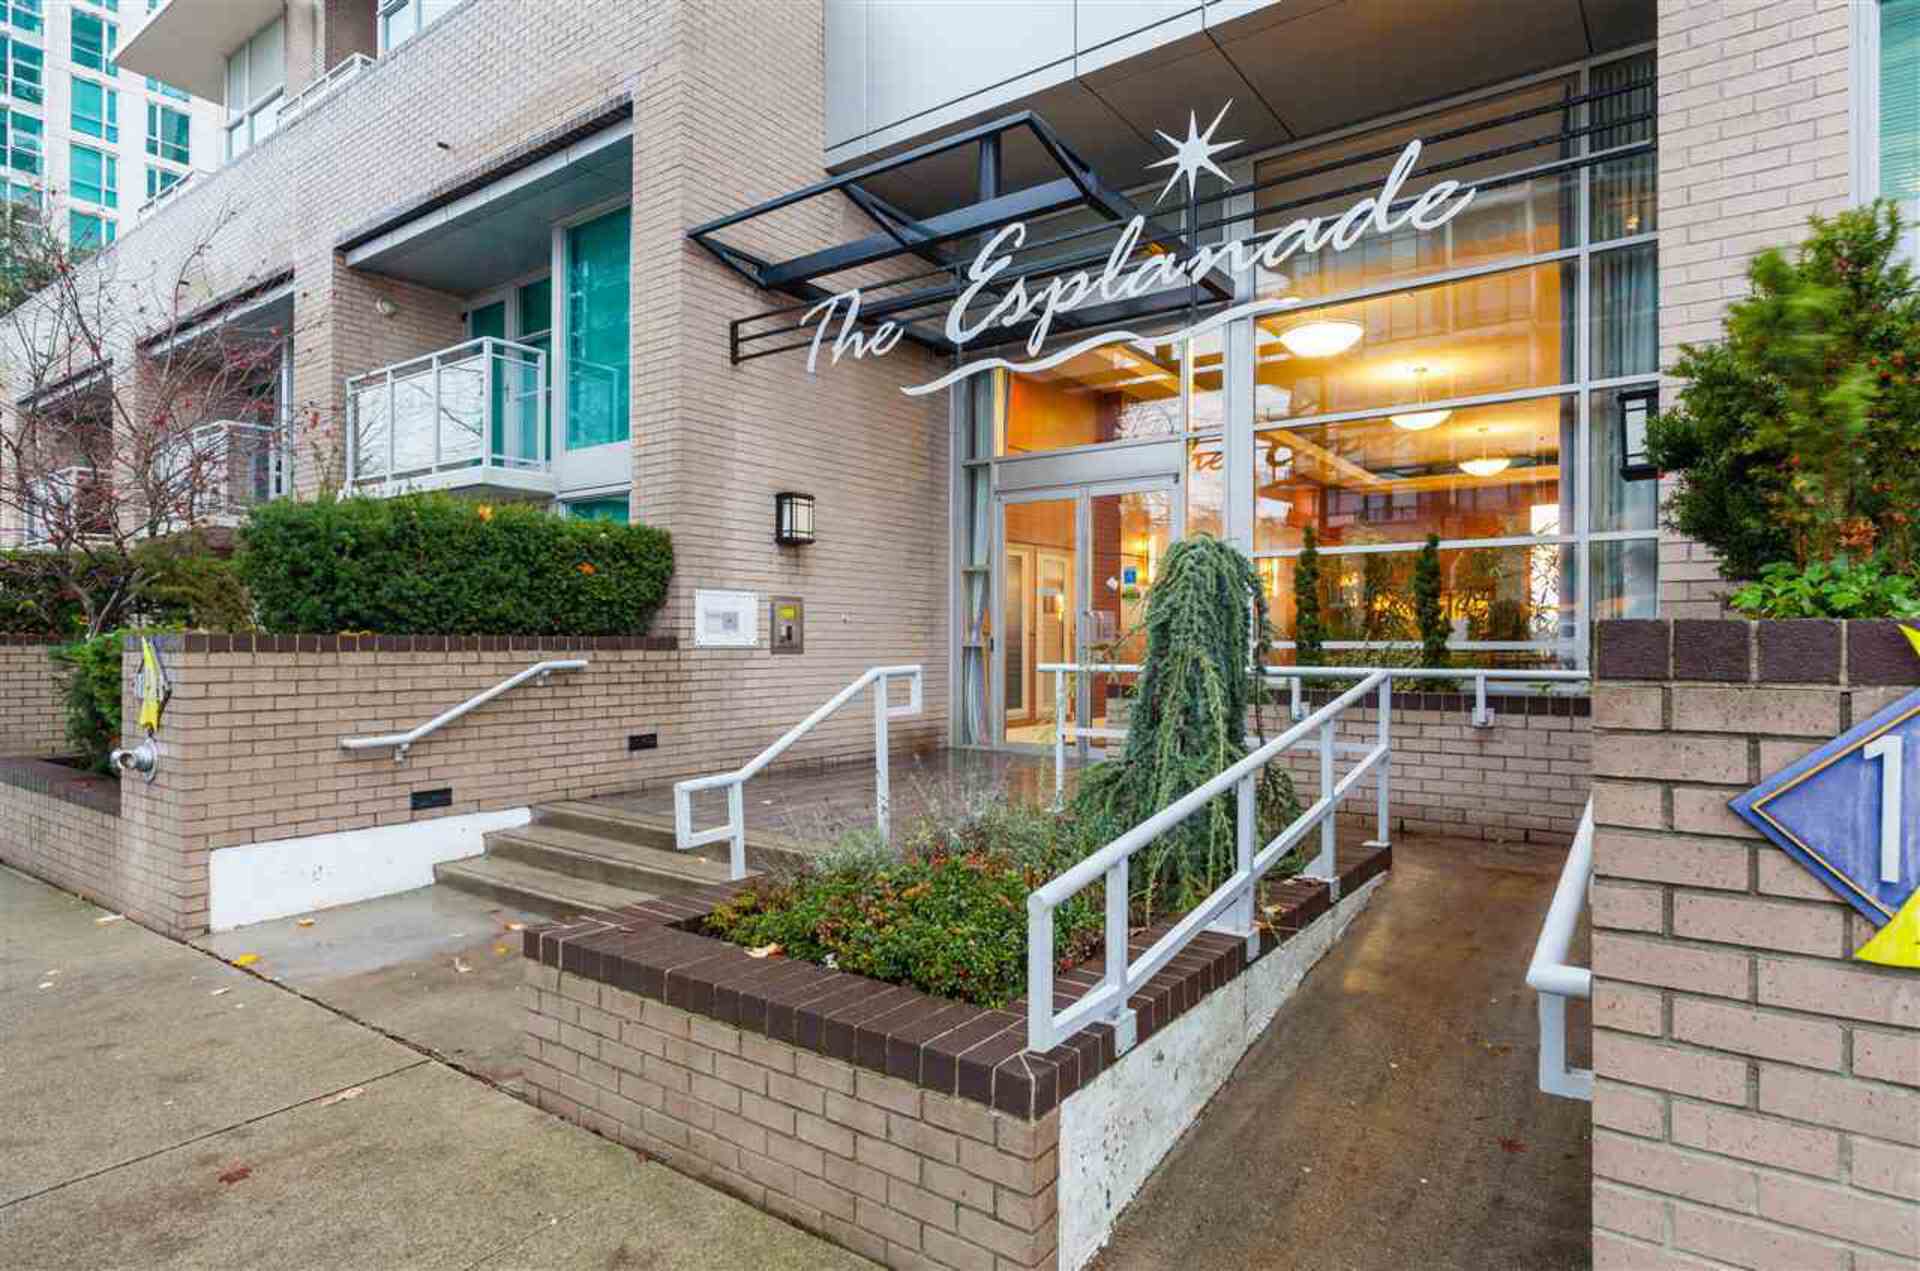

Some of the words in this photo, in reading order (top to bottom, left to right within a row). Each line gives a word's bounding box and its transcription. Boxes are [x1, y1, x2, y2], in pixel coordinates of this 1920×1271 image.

[800, 289, 904, 373] The
[945, 138, 1476, 356] Esplanade
[1863, 734, 1902, 884] 1
